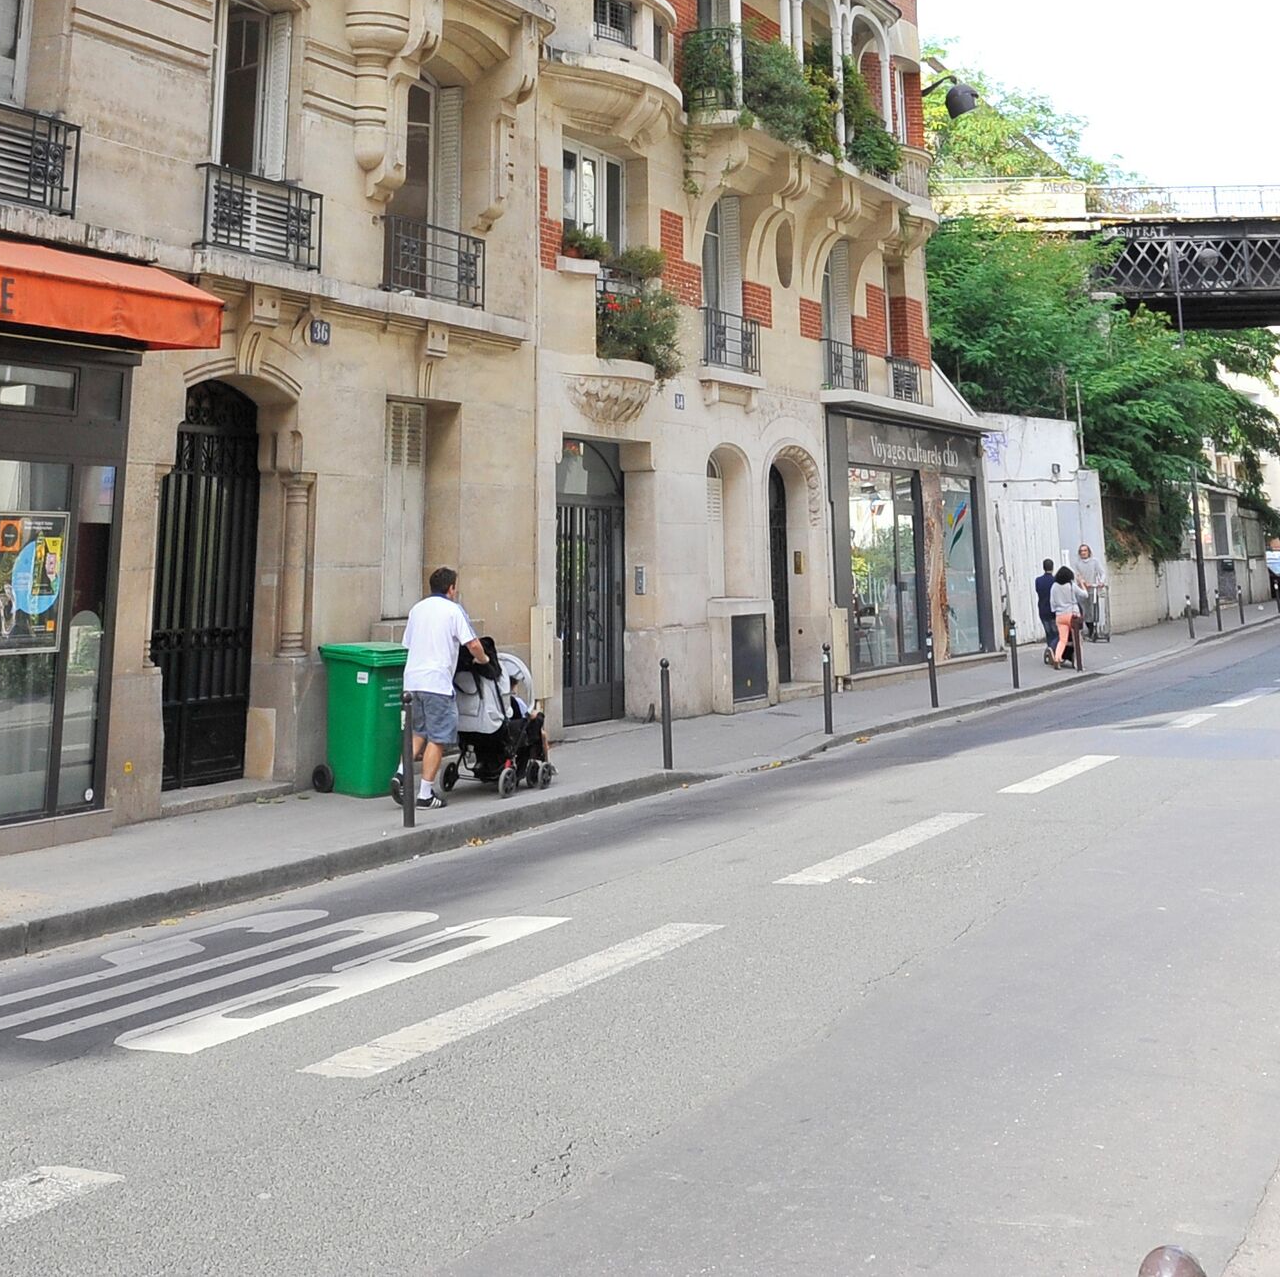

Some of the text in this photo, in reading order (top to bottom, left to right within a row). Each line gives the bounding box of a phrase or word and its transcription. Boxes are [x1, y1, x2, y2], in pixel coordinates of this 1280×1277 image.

[314, 322, 328, 341] 36
[870, 435, 907, 466] Voyages
[906, 441, 942, 467] culturels
